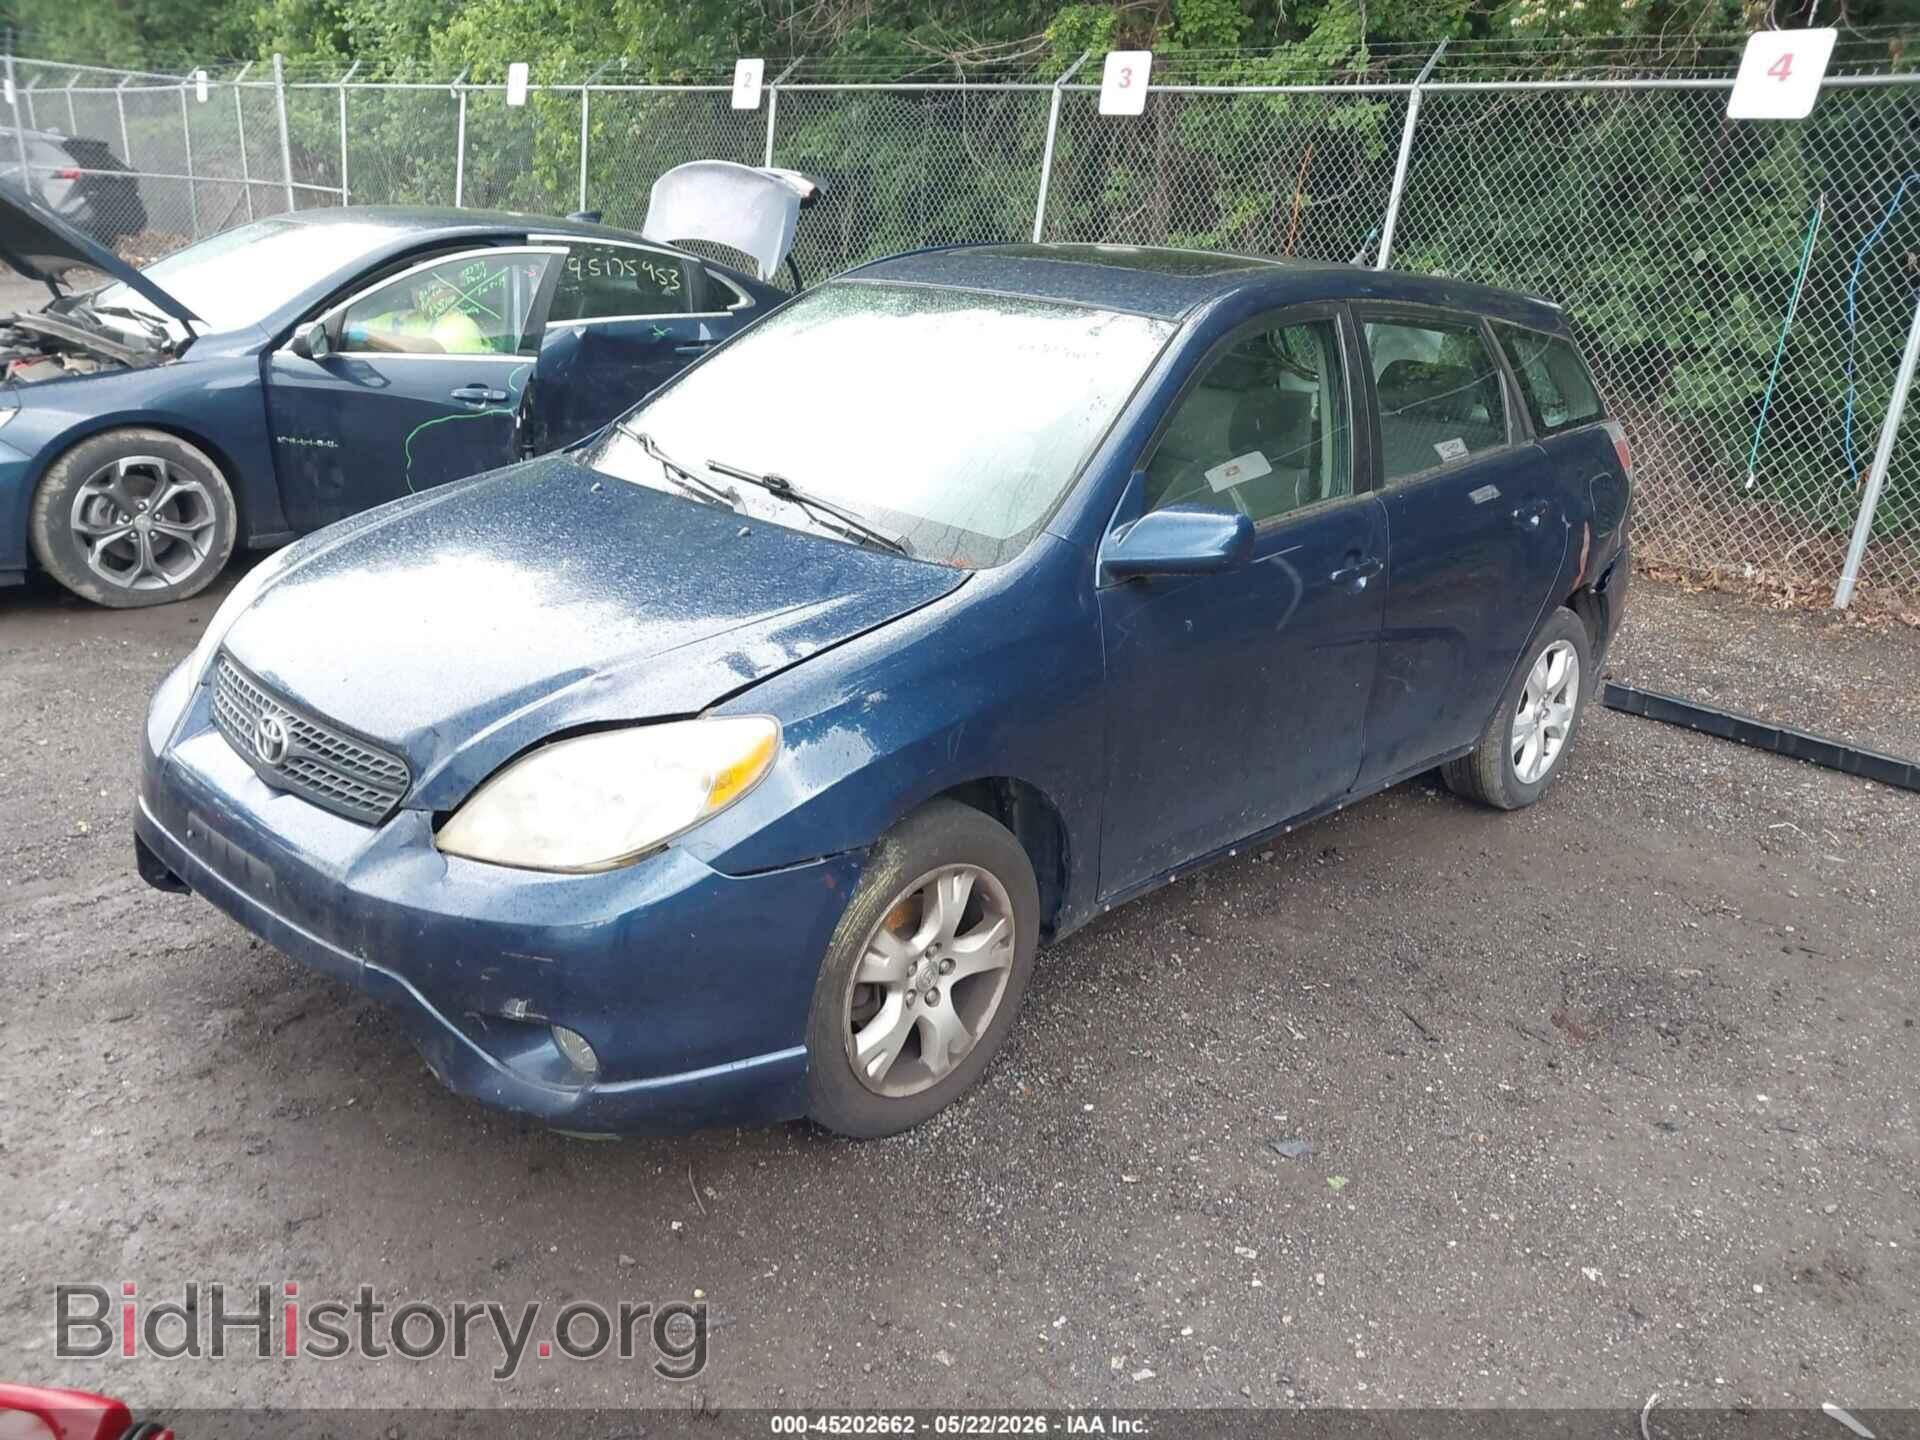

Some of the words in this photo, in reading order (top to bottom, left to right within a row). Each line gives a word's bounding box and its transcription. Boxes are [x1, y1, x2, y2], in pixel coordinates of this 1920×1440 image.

[1118, 67, 1133, 89] 3
[1767, 53, 1794, 82] 4
[743, 71, 753, 89] 2
